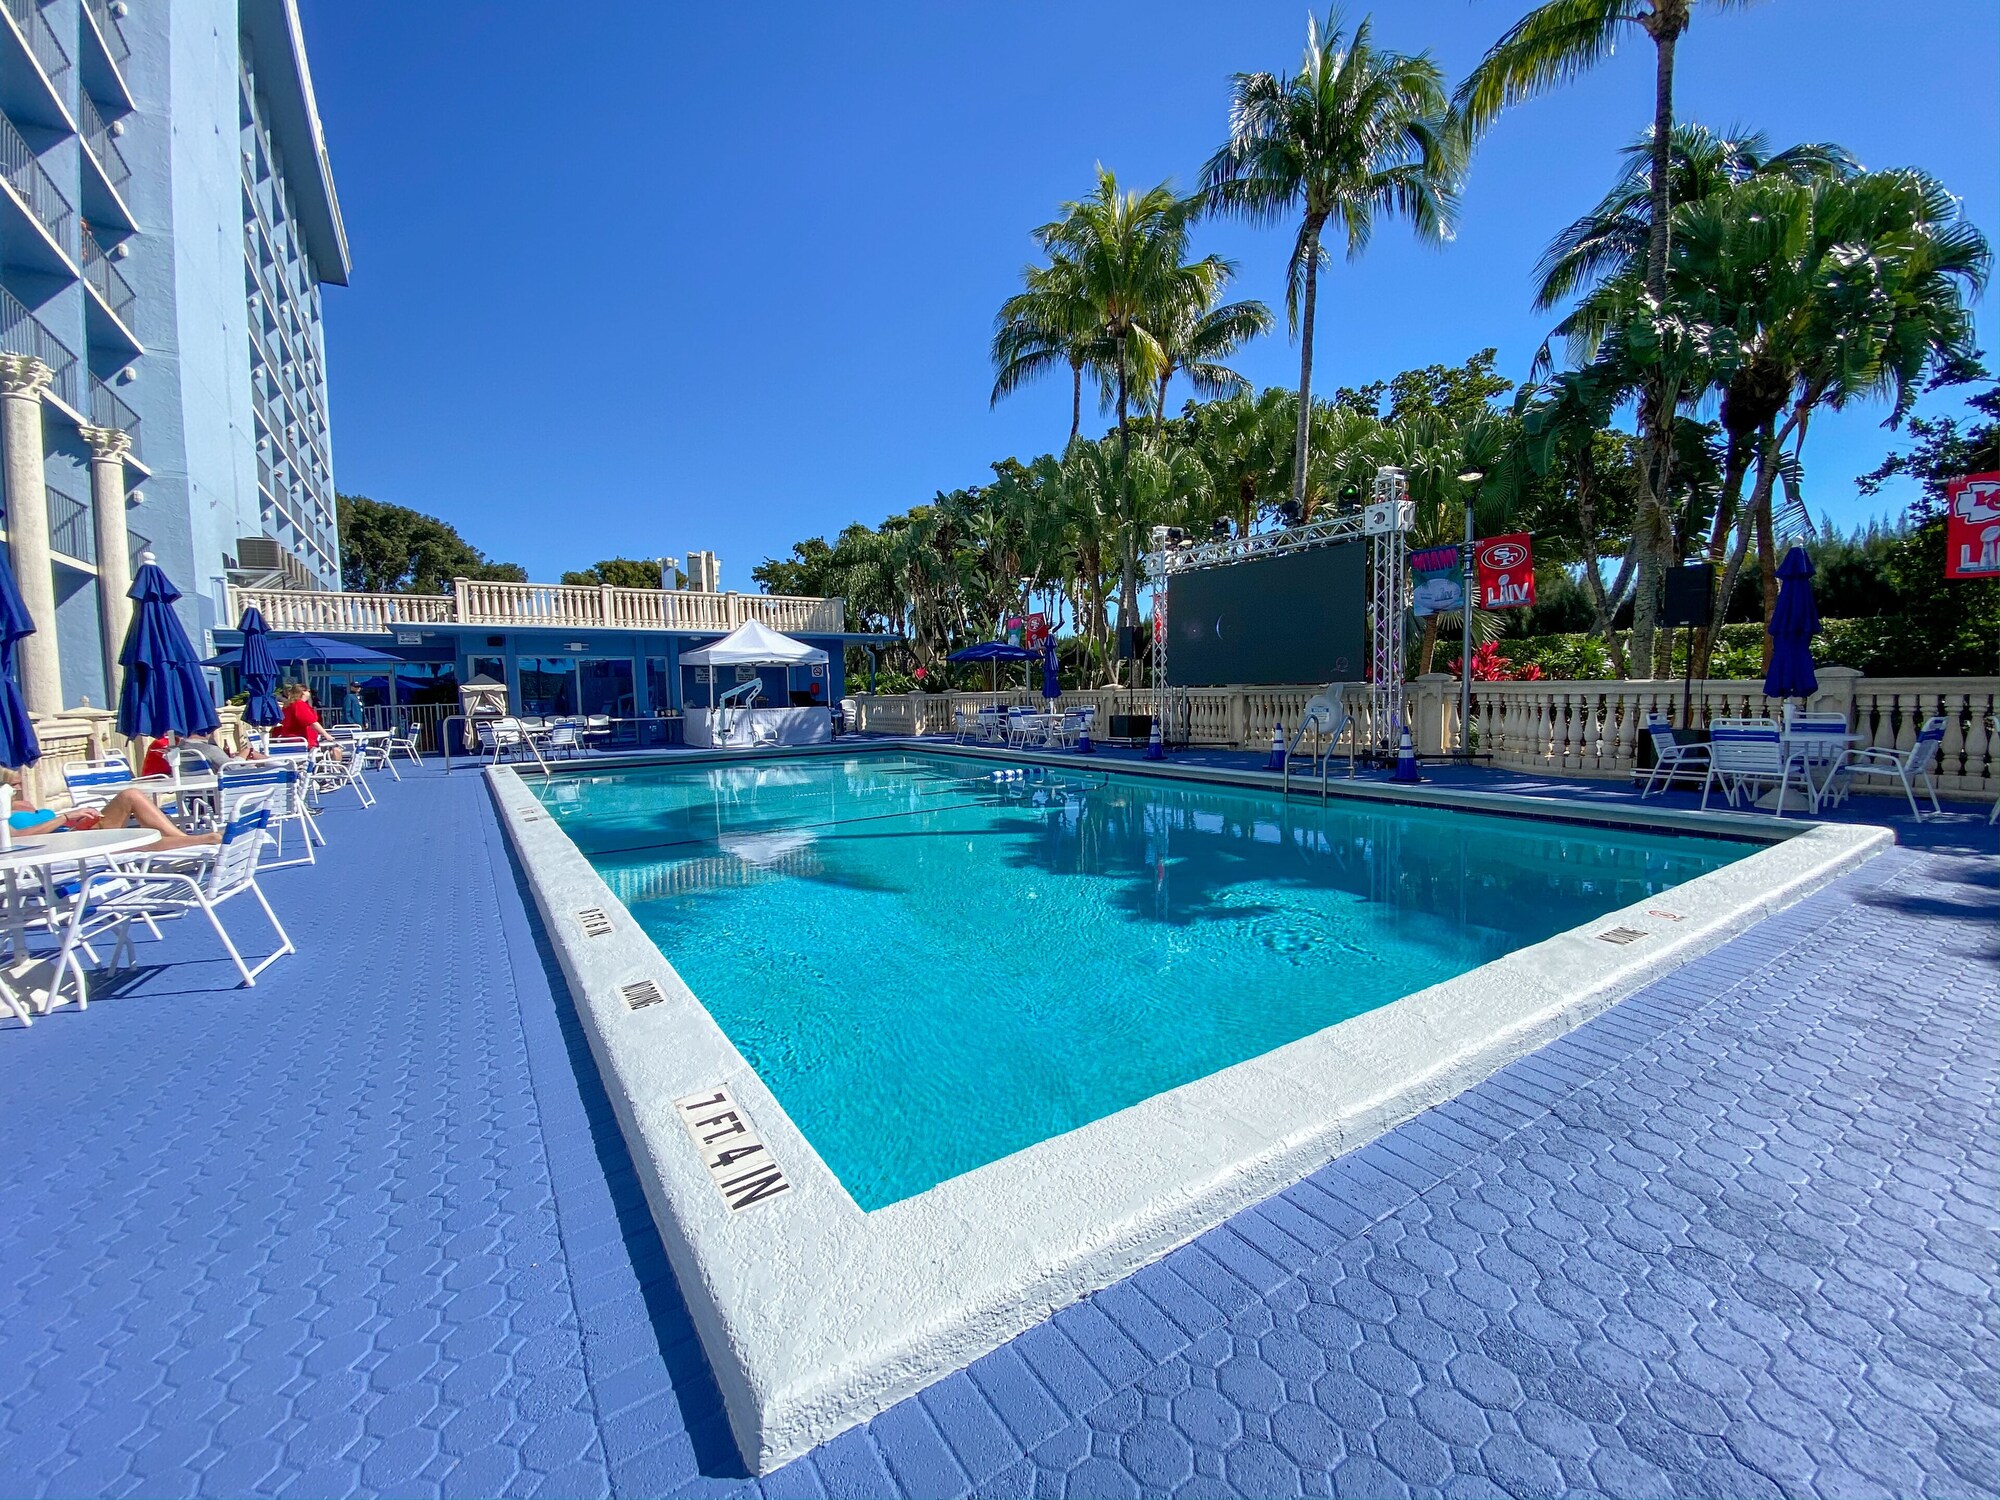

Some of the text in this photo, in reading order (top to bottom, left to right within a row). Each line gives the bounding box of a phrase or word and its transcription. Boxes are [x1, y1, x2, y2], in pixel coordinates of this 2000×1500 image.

[587, 926, 613, 937] IN
[621, 979, 664, 1010] NO DIVING
[686, 1092, 727, 1111] 7
[709, 1144, 764, 1169] 4
[720, 1163, 790, 1211] IN
